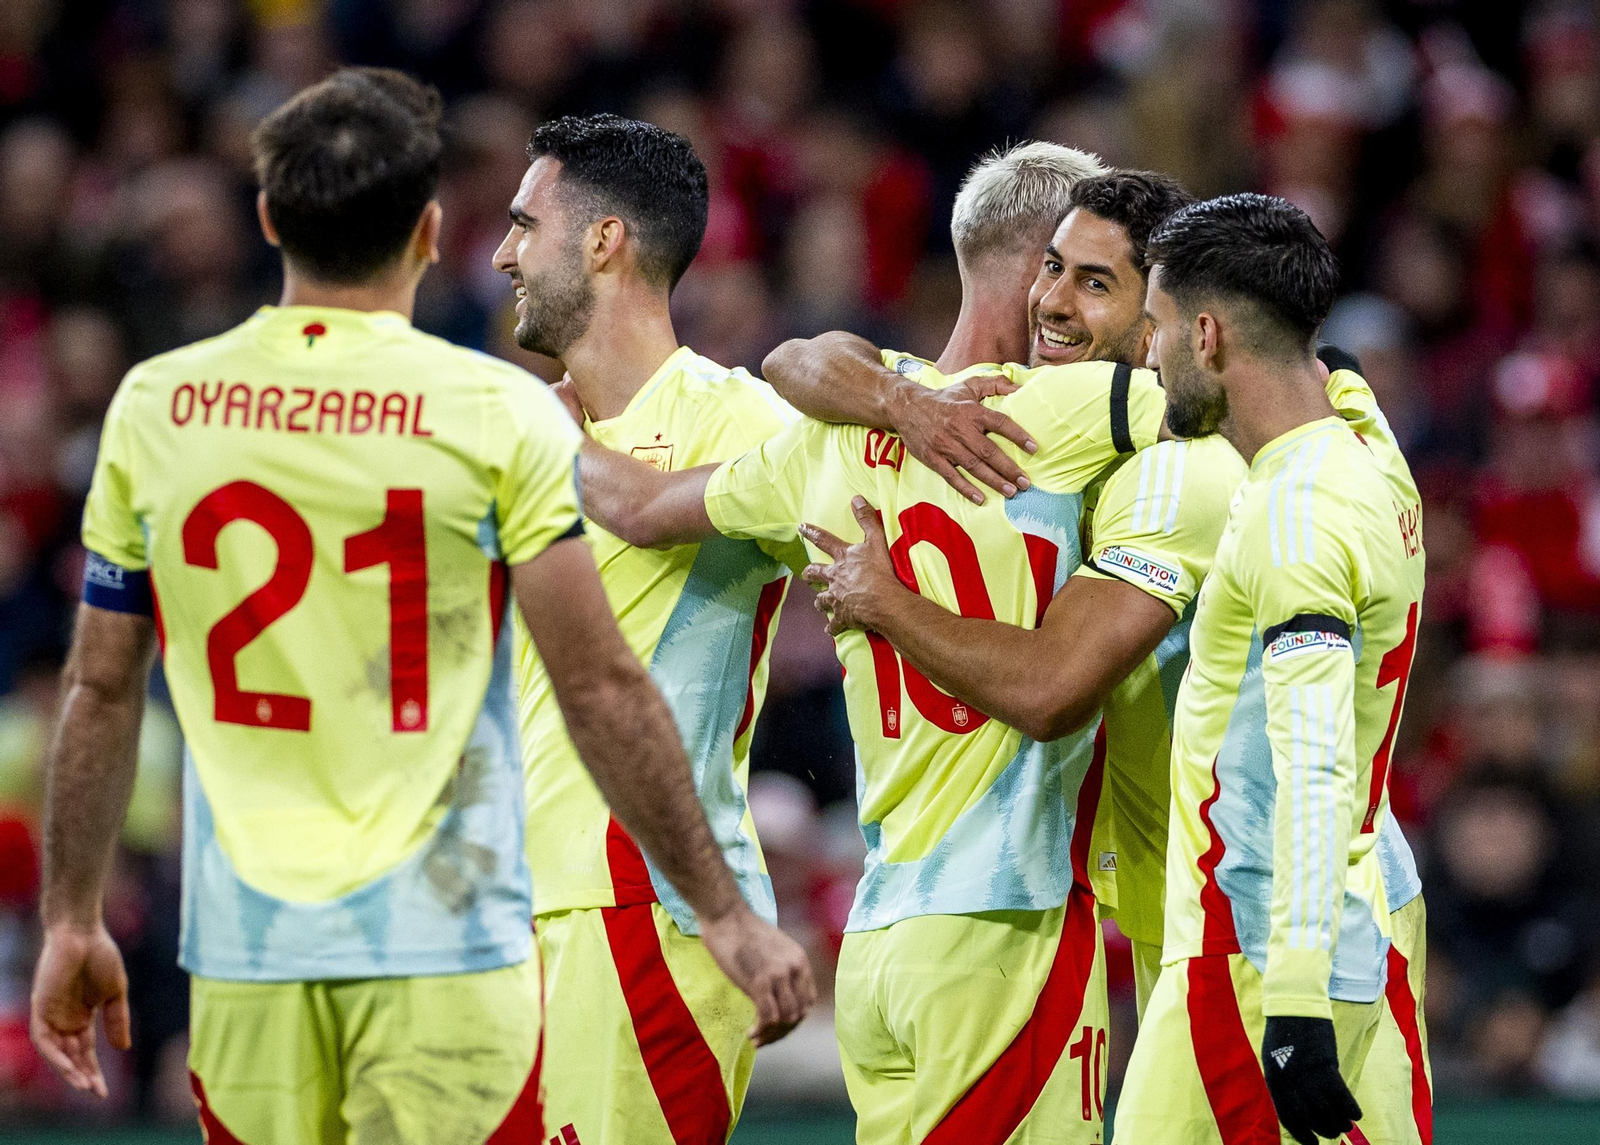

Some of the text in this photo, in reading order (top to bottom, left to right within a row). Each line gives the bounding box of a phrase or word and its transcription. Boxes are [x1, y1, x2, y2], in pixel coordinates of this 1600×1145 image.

[171, 382, 434, 438] OYARZABAL
[181, 479, 429, 734] 21
[1070, 1026, 1106, 1123] 10
